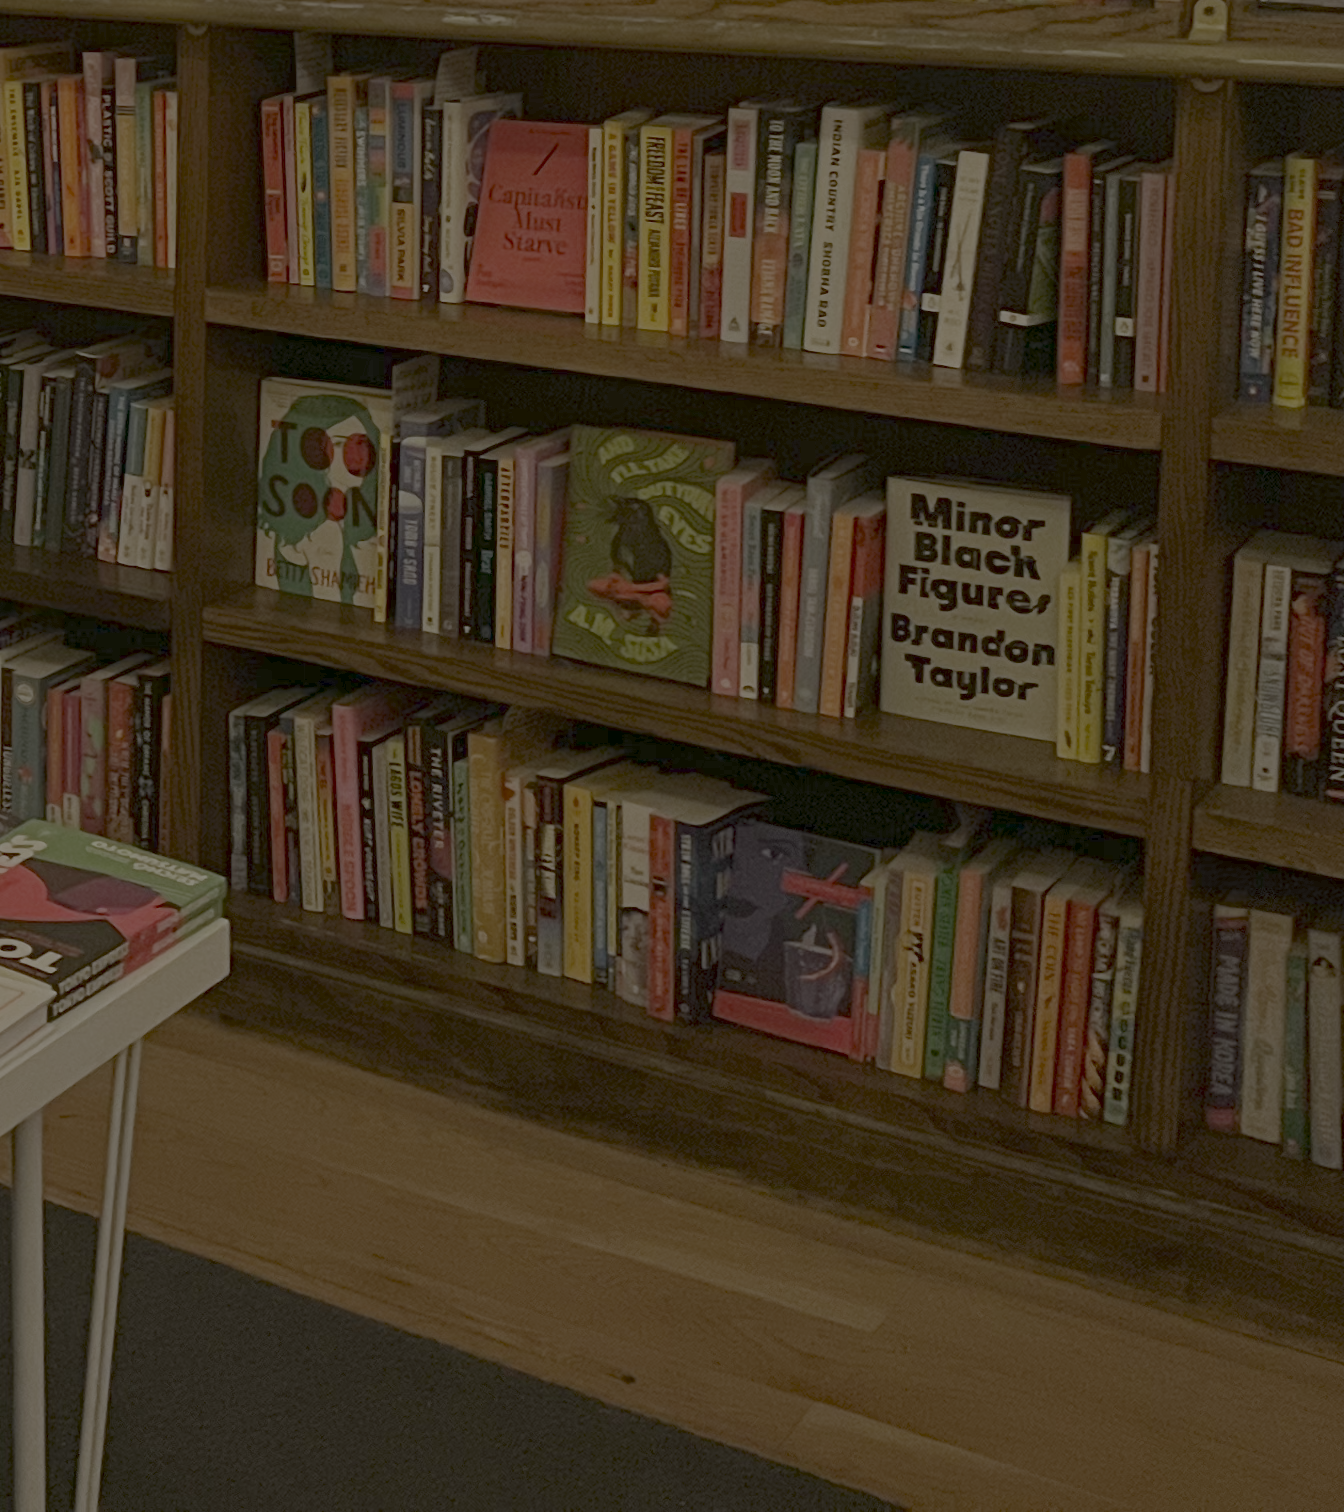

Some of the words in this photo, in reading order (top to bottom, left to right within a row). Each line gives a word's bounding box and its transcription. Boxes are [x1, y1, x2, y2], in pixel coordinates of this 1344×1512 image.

[101, 93, 113, 149] PLASTIC
[395, 101, 408, 170] LUMINOUS
[767, 119, 785, 132] TO
[336, 136, 350, 170] FICTION
[608, 145, 620, 176] GAME
[766, 134, 785, 152] THE
[830, 118, 844, 166] INDIAN
[645, 136, 665, 187] FREEDOM
[766, 154, 784, 184] MOON
[103, 170, 115, 209] SCOTT
[607, 180, 619, 195] IN
[765, 184, 784, 207] AND
[825, 170, 840, 232] COUNTRY
[396, 208, 408, 245] SILVIA
[515, 209, 562, 234] Must
[606, 198, 619, 245] YELLOW
[645, 193, 664, 226] FEAST
[765, 207, 783, 234] BACK
[104, 214, 116, 255] GUILD
[503, 231, 570, 256] Starve
[646, 228, 660, 266] ALEJANDRO
[1289, 208, 1305, 250] BAD
[396, 248, 408, 283] PARK
[819, 241, 834, 296] SHOBHA
[1253, 272, 1265, 297] LIVE
[816, 300, 828, 329] RAO
[1284, 253, 1304, 361] INFLUENCE
[1249, 334, 1261, 359] NOW
[271, 420, 377, 477] TOO
[262, 475, 377, 532] SOON
[499, 466, 511, 551] AFTERPARTIES
[911, 493, 1045, 540] Minor
[660, 505, 712, 554] EYES
[914, 531, 1041, 580] Black
[266, 557, 309, 584] BETTY
[311, 566, 376, 595] SHAMIEH
[898, 565, 1050, 615] Figures
[620, 634, 678, 663] SOSA
[890, 611, 1055, 666] Brandon
[905, 653, 1039, 700] Taylor
[1297, 649, 1315, 672] OF
[1293, 676, 1315, 753] DARKNESS
[388, 762, 404, 797] LAGOS
[430, 747, 443, 778] THE
[390, 800, 404, 829] WIFE
[412, 771, 427, 831] LONELY
[432, 781, 444, 849] RIVETER
[413, 837, 429, 908] CROWDS
[1046, 912, 1061, 941] THE
[992, 937, 1006, 956] ART
[1043, 944, 1059, 982] COIN
[990, 974, 1004, 995] FIRE
[1222, 955, 1242, 1007] MADE
[1219, 1011, 1238, 1035] IN
[1214, 1040, 1236, 1095] KOREA
